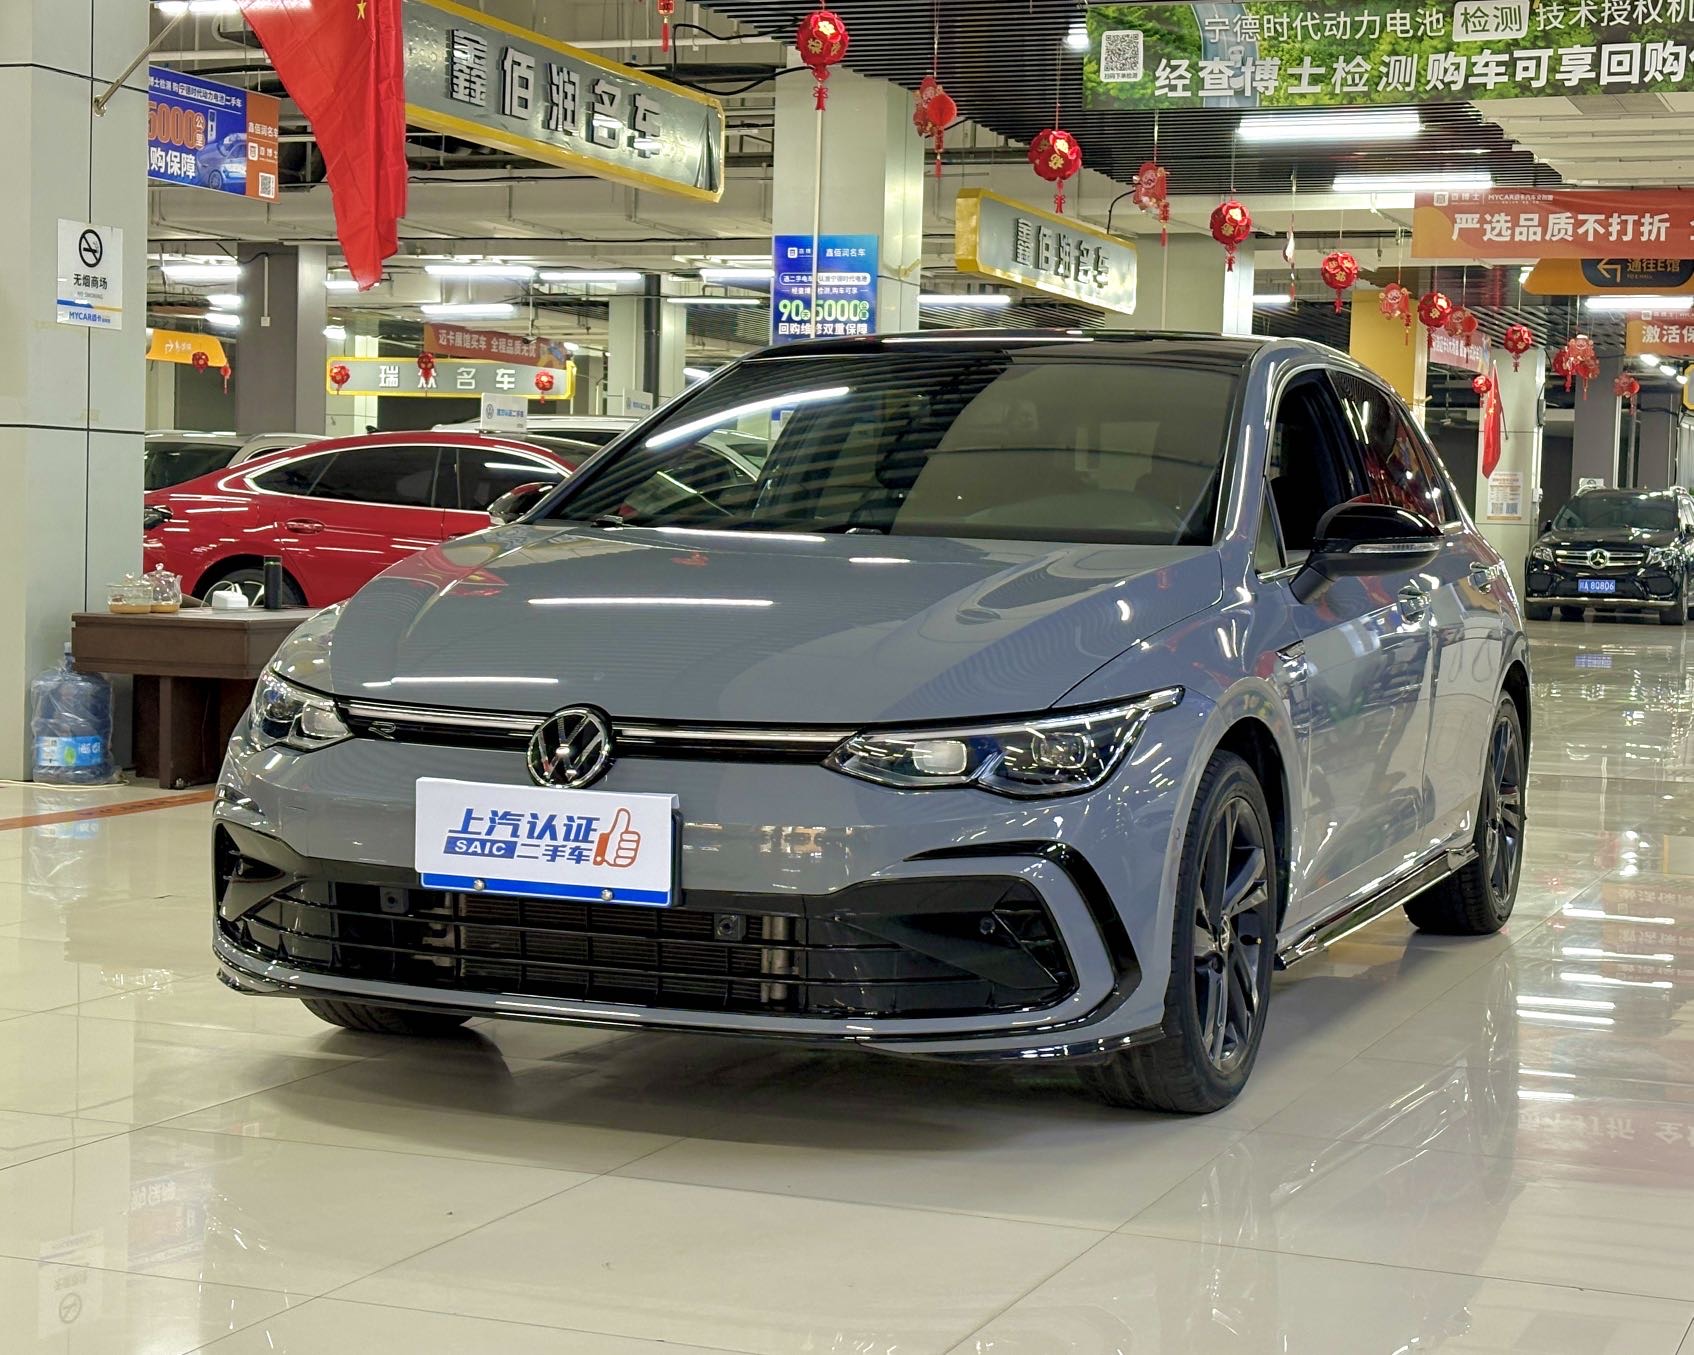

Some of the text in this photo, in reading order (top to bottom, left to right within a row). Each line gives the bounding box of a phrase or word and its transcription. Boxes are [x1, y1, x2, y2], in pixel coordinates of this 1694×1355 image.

[1204, 8, 1445, 43] 宁德时代动力电池
[1459, 5, 1523, 35] 检测
[449, 28, 661, 159] 鑫佰润名车
[148, 146, 196, 179] 购保障
[1452, 213, 1670, 242] 严选品质不打折
[73, 273, 108, 290] 无烟商场
[448, 807, 601, 845] 上汽认证
[454, 839, 594, 865] SAIC 二手车
